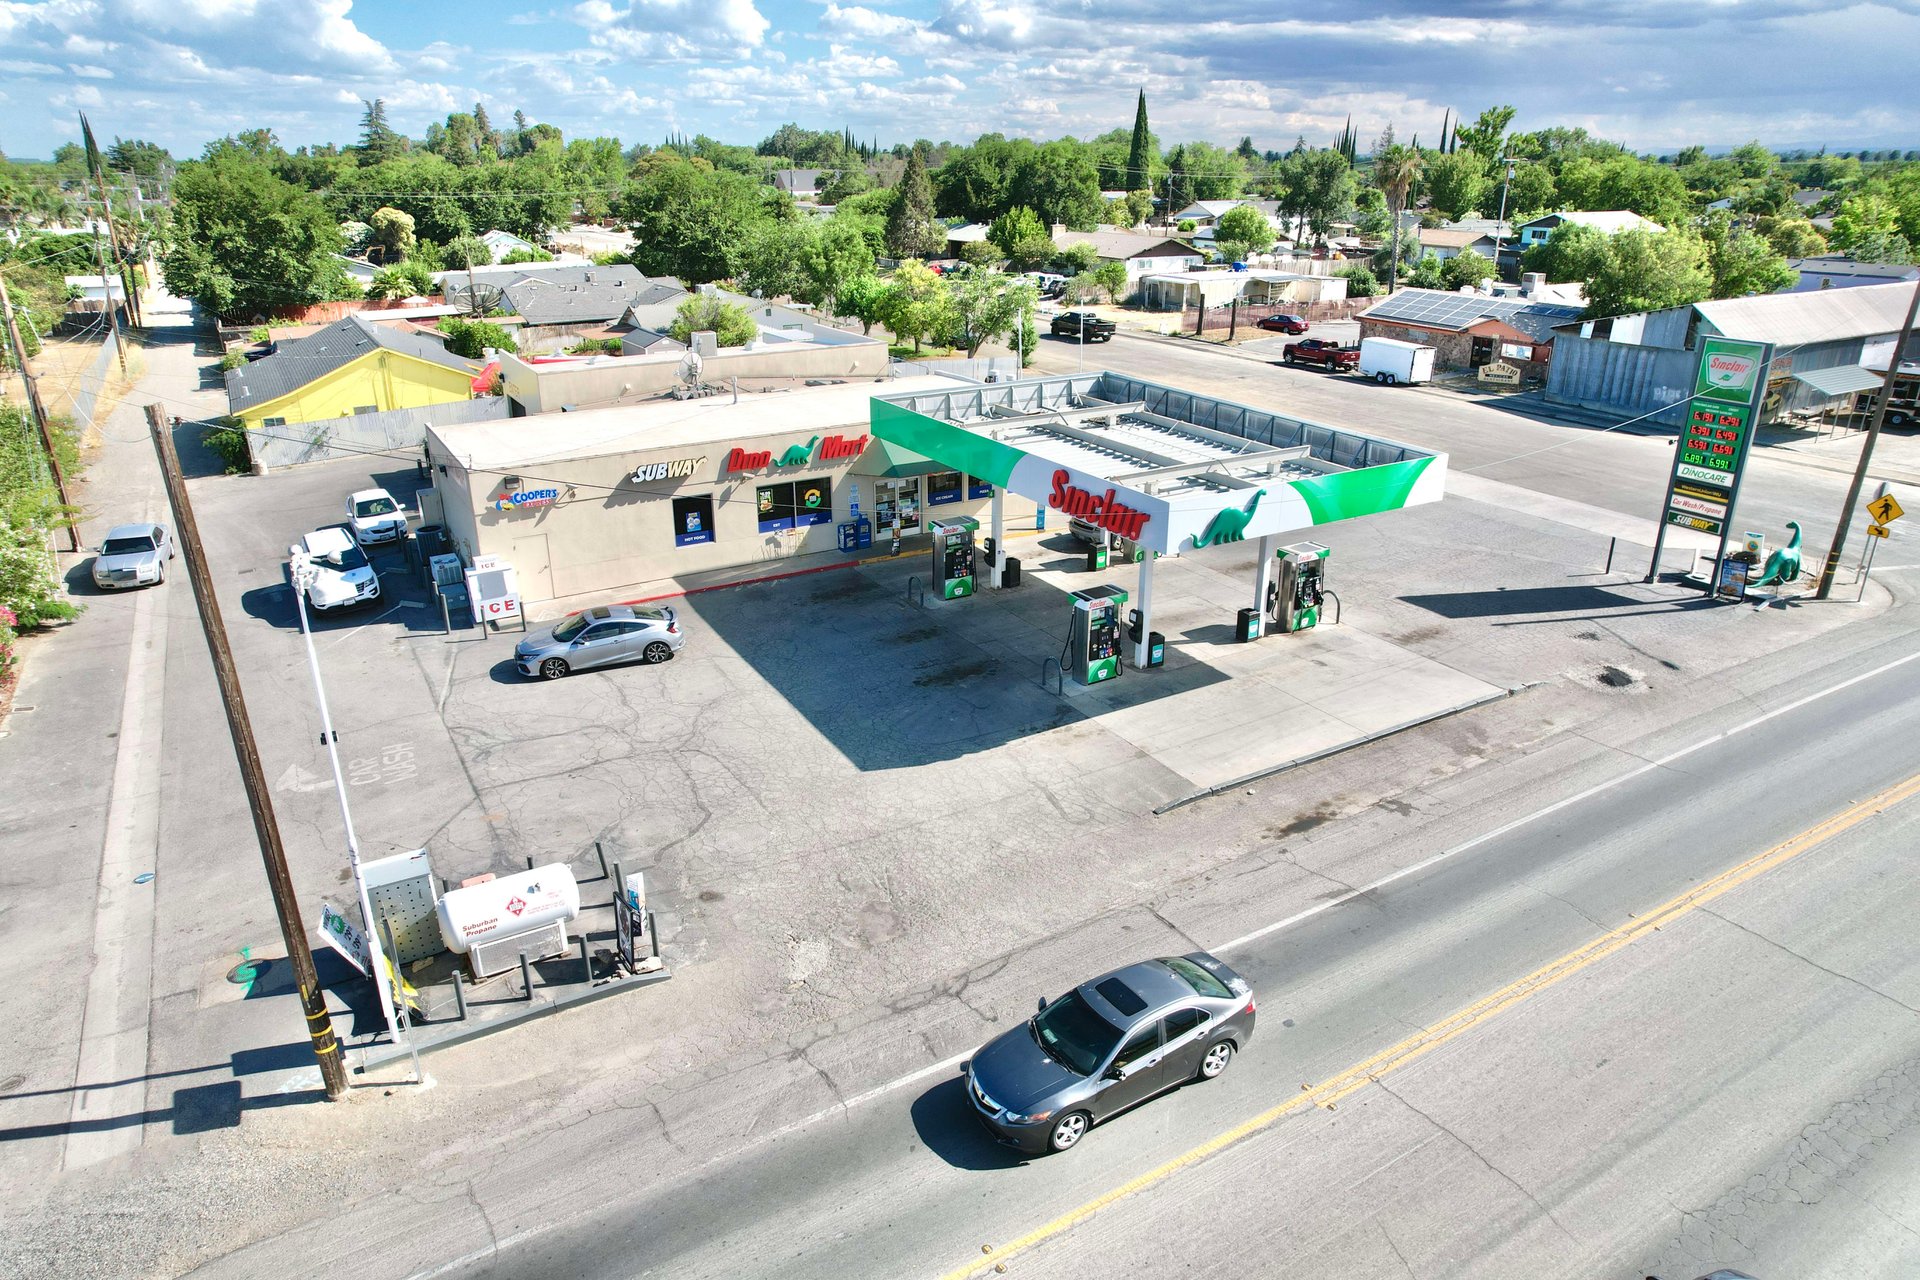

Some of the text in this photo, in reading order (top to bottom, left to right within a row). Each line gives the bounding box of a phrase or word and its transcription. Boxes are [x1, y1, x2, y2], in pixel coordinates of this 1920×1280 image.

[1482, 364, 1518, 376] EL PATIO
[1710, 357, 1750, 373] Sinclair
[727, 434, 868, 473] Dino Mart
[631, 456, 707, 483] SUBWAY
[1681, 467, 1727, 483] DINOCARE
[513, 489, 557, 504] COOPER'S
[1048, 469, 1151, 541] Sinclair
[1674, 514, 1714, 529] SUBWAY
[348, 756, 381, 786] CAR
[381, 741, 418, 785] WASH
[462, 917, 499, 932] Suburban
[466, 924, 497, 937] Propane
